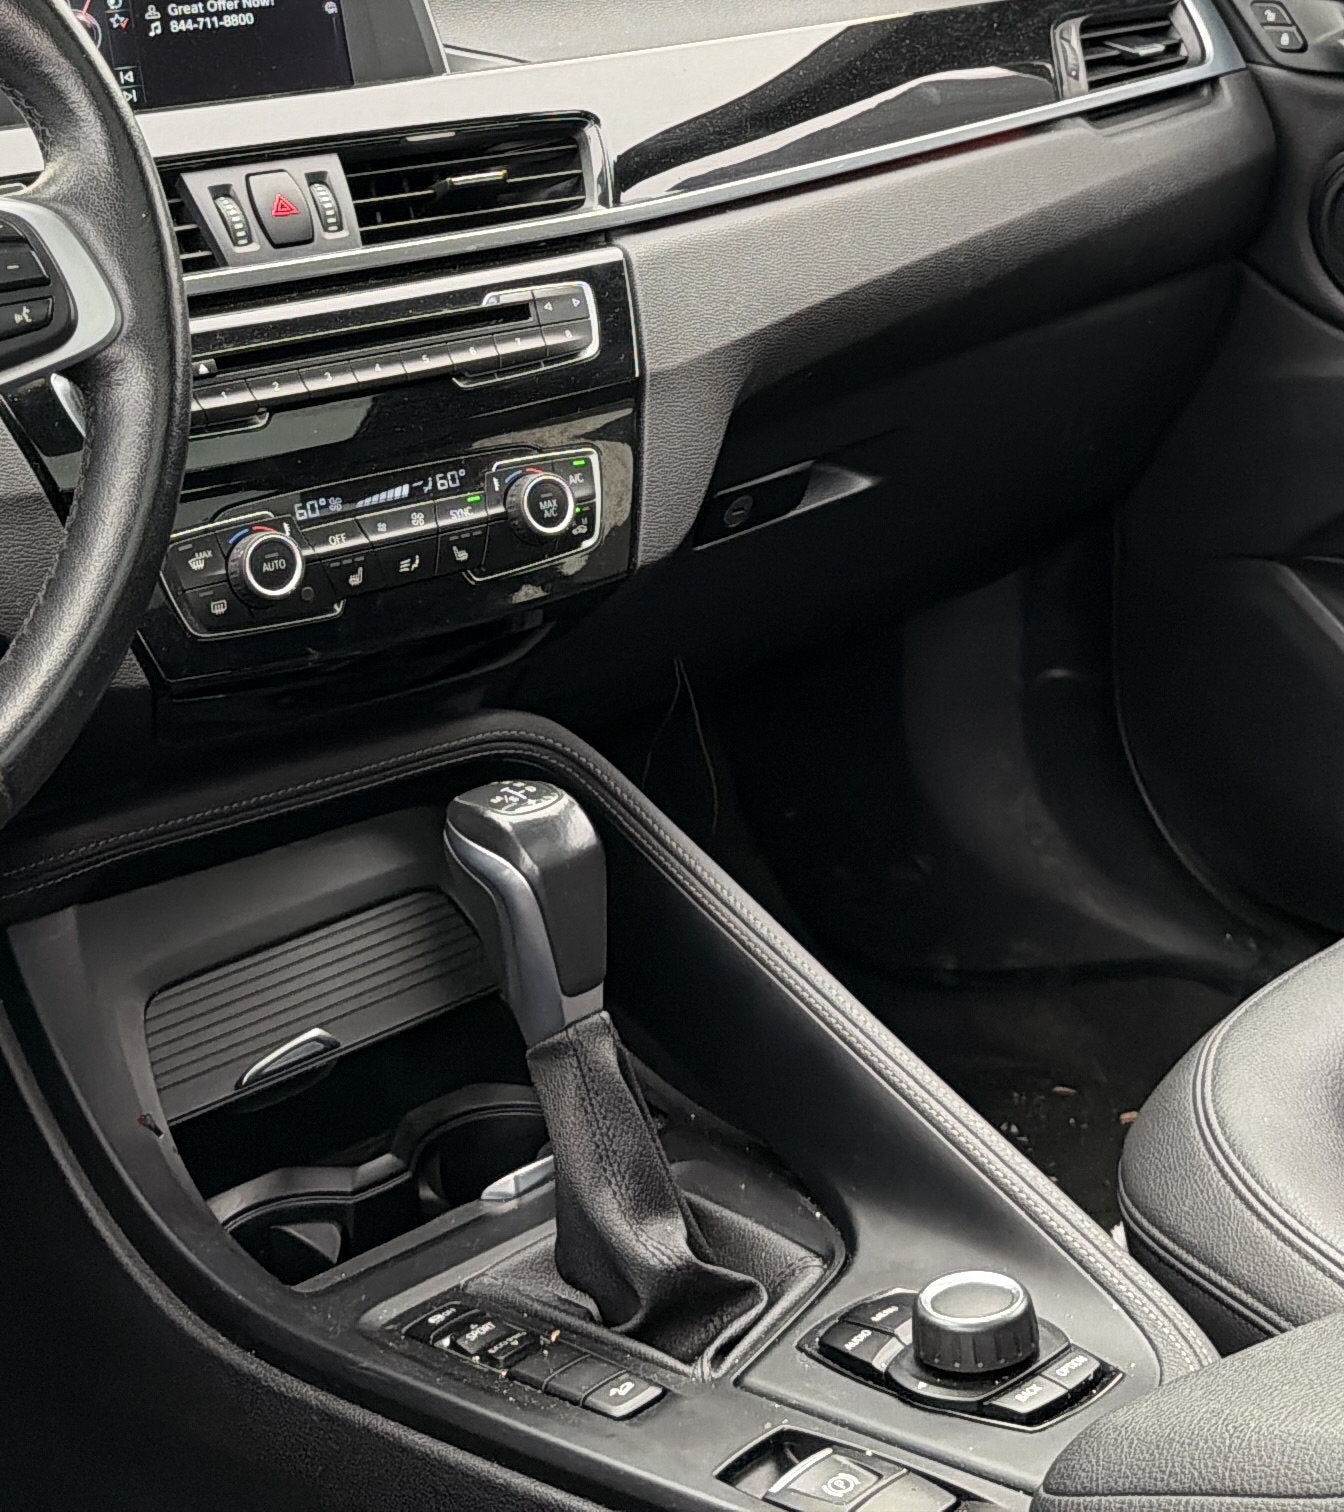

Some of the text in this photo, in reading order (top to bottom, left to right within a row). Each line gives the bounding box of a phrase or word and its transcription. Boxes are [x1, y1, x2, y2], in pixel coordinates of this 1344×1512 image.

[167, 2, 205, 17] Great
[170, 12, 255, 33] 844-711-8800
[568, 473, 585, 486] A/C
[538, 499, 559, 511] MAX
[449, 506, 474, 520] SYNC
[543, 508, 558, 519] A/C
[328, 532, 347, 546] OFF
[194, 549, 214, 560] MAX
[262, 558, 287, 573] AUTO
[844, 1329, 873, 1351] AUDIO
[1055, 1354, 1090, 1377] OPTION
